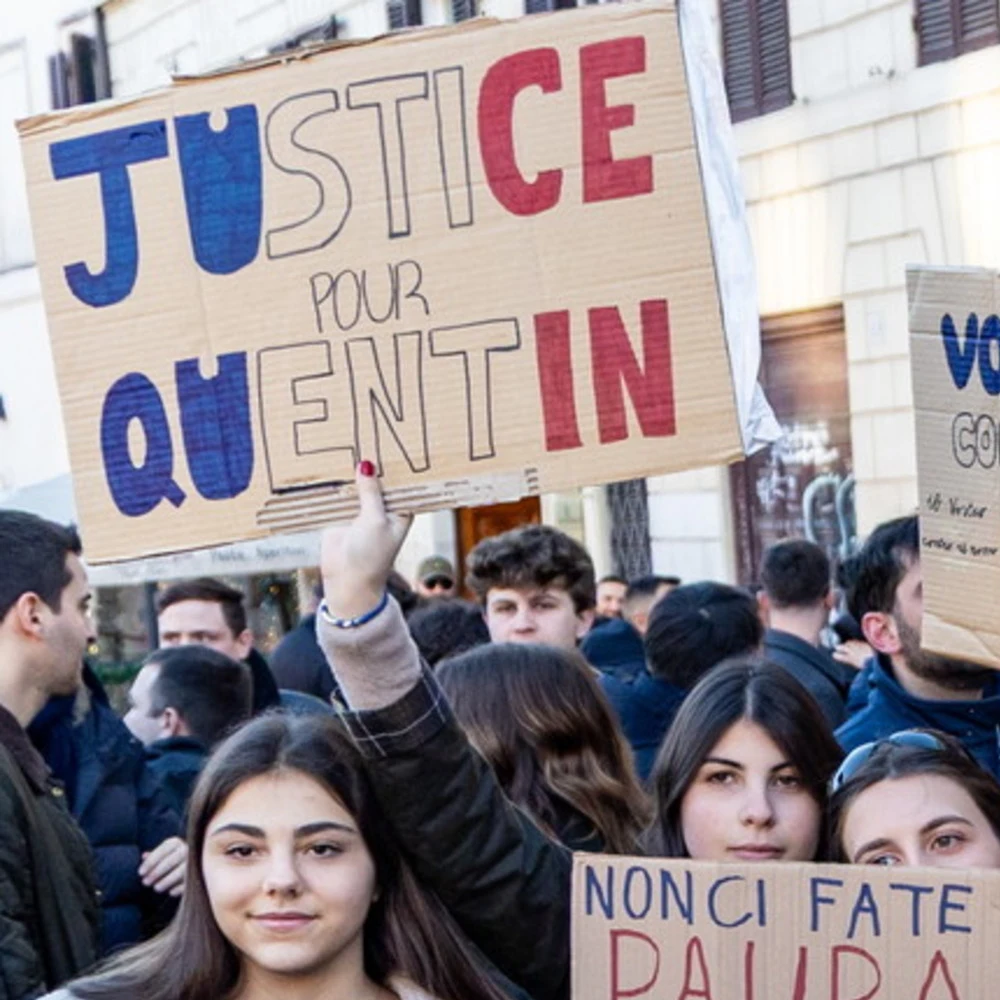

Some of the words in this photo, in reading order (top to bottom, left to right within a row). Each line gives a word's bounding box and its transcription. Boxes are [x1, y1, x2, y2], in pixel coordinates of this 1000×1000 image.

[48, 35, 655, 309] JUSTICE
[309, 260, 430, 332] POUR
[100, 298, 677, 518] QUENTIN
[585, 865, 694, 926] NON
[707, 875, 766, 929] CI
[809, 877, 974, 939] FATE
